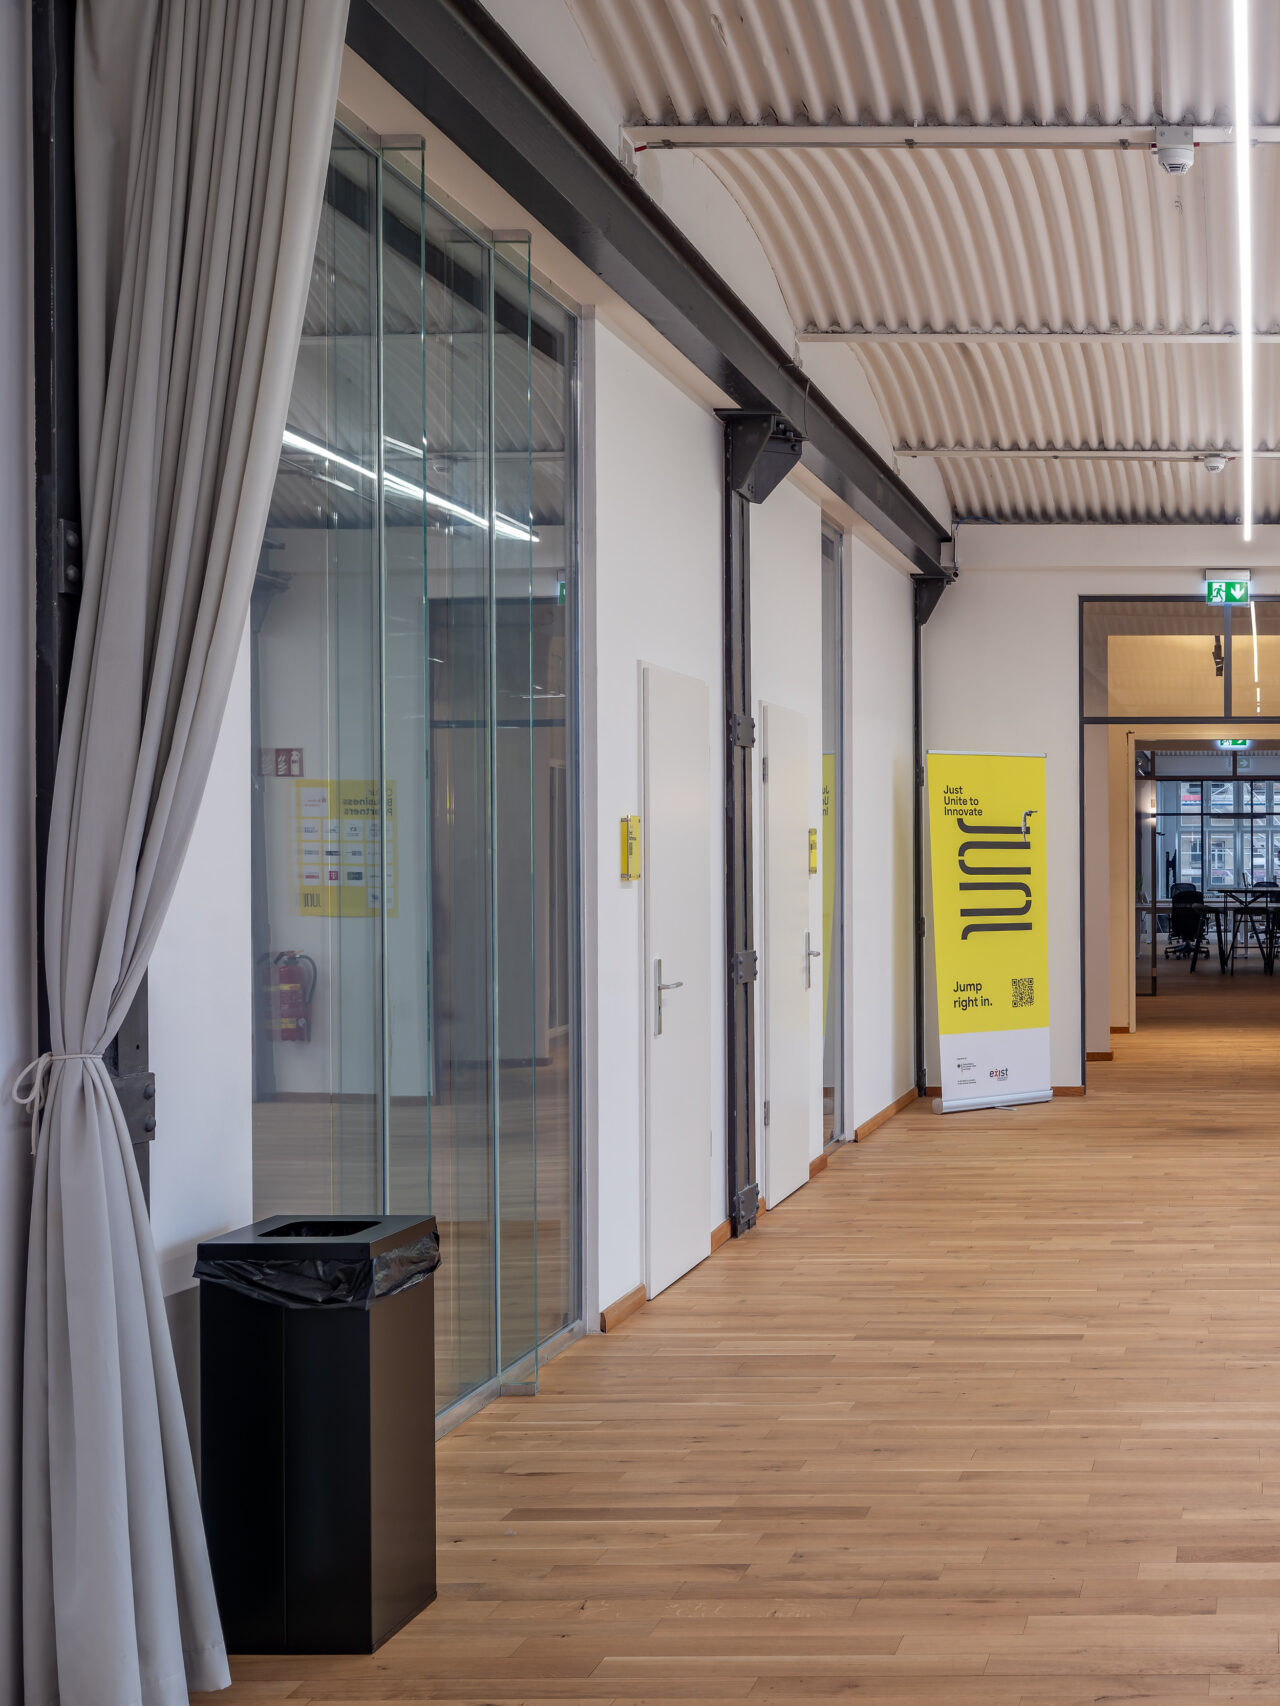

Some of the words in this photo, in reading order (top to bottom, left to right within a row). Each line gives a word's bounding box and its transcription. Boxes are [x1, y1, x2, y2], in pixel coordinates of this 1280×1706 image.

[943, 785, 963, 795] Just
[944, 796, 968, 806] Unite
[969, 796, 979, 806] to
[944, 806, 983, 816] Innovate
[953, 981, 983, 994] Jump
[953, 997, 978, 1011] right
[980, 996, 993, 1007] in.
[989, 1067, 1009, 1078] exist
